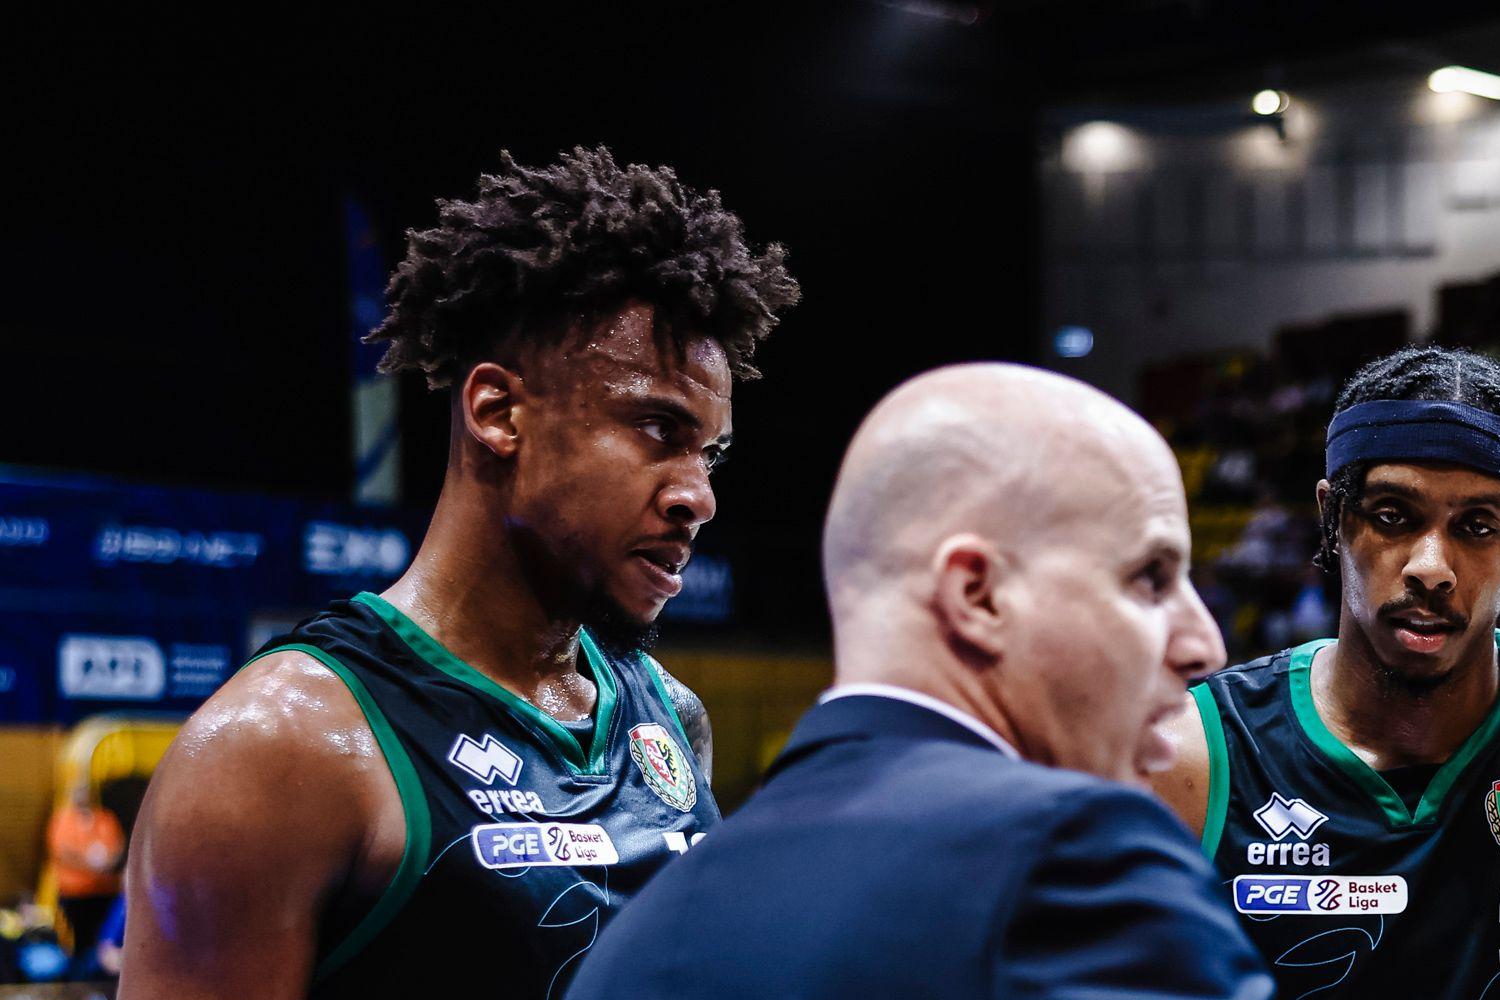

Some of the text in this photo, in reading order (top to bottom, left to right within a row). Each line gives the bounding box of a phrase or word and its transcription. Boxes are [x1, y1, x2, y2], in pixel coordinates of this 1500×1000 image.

[568, 829, 605, 844] Basket
[492, 833, 541, 858] PGE
[575, 849, 598, 862] Liga
[1246, 885, 1302, 905] PGE
[1348, 881, 1398, 894] Basket
[1348, 896, 1379, 911] Liga
